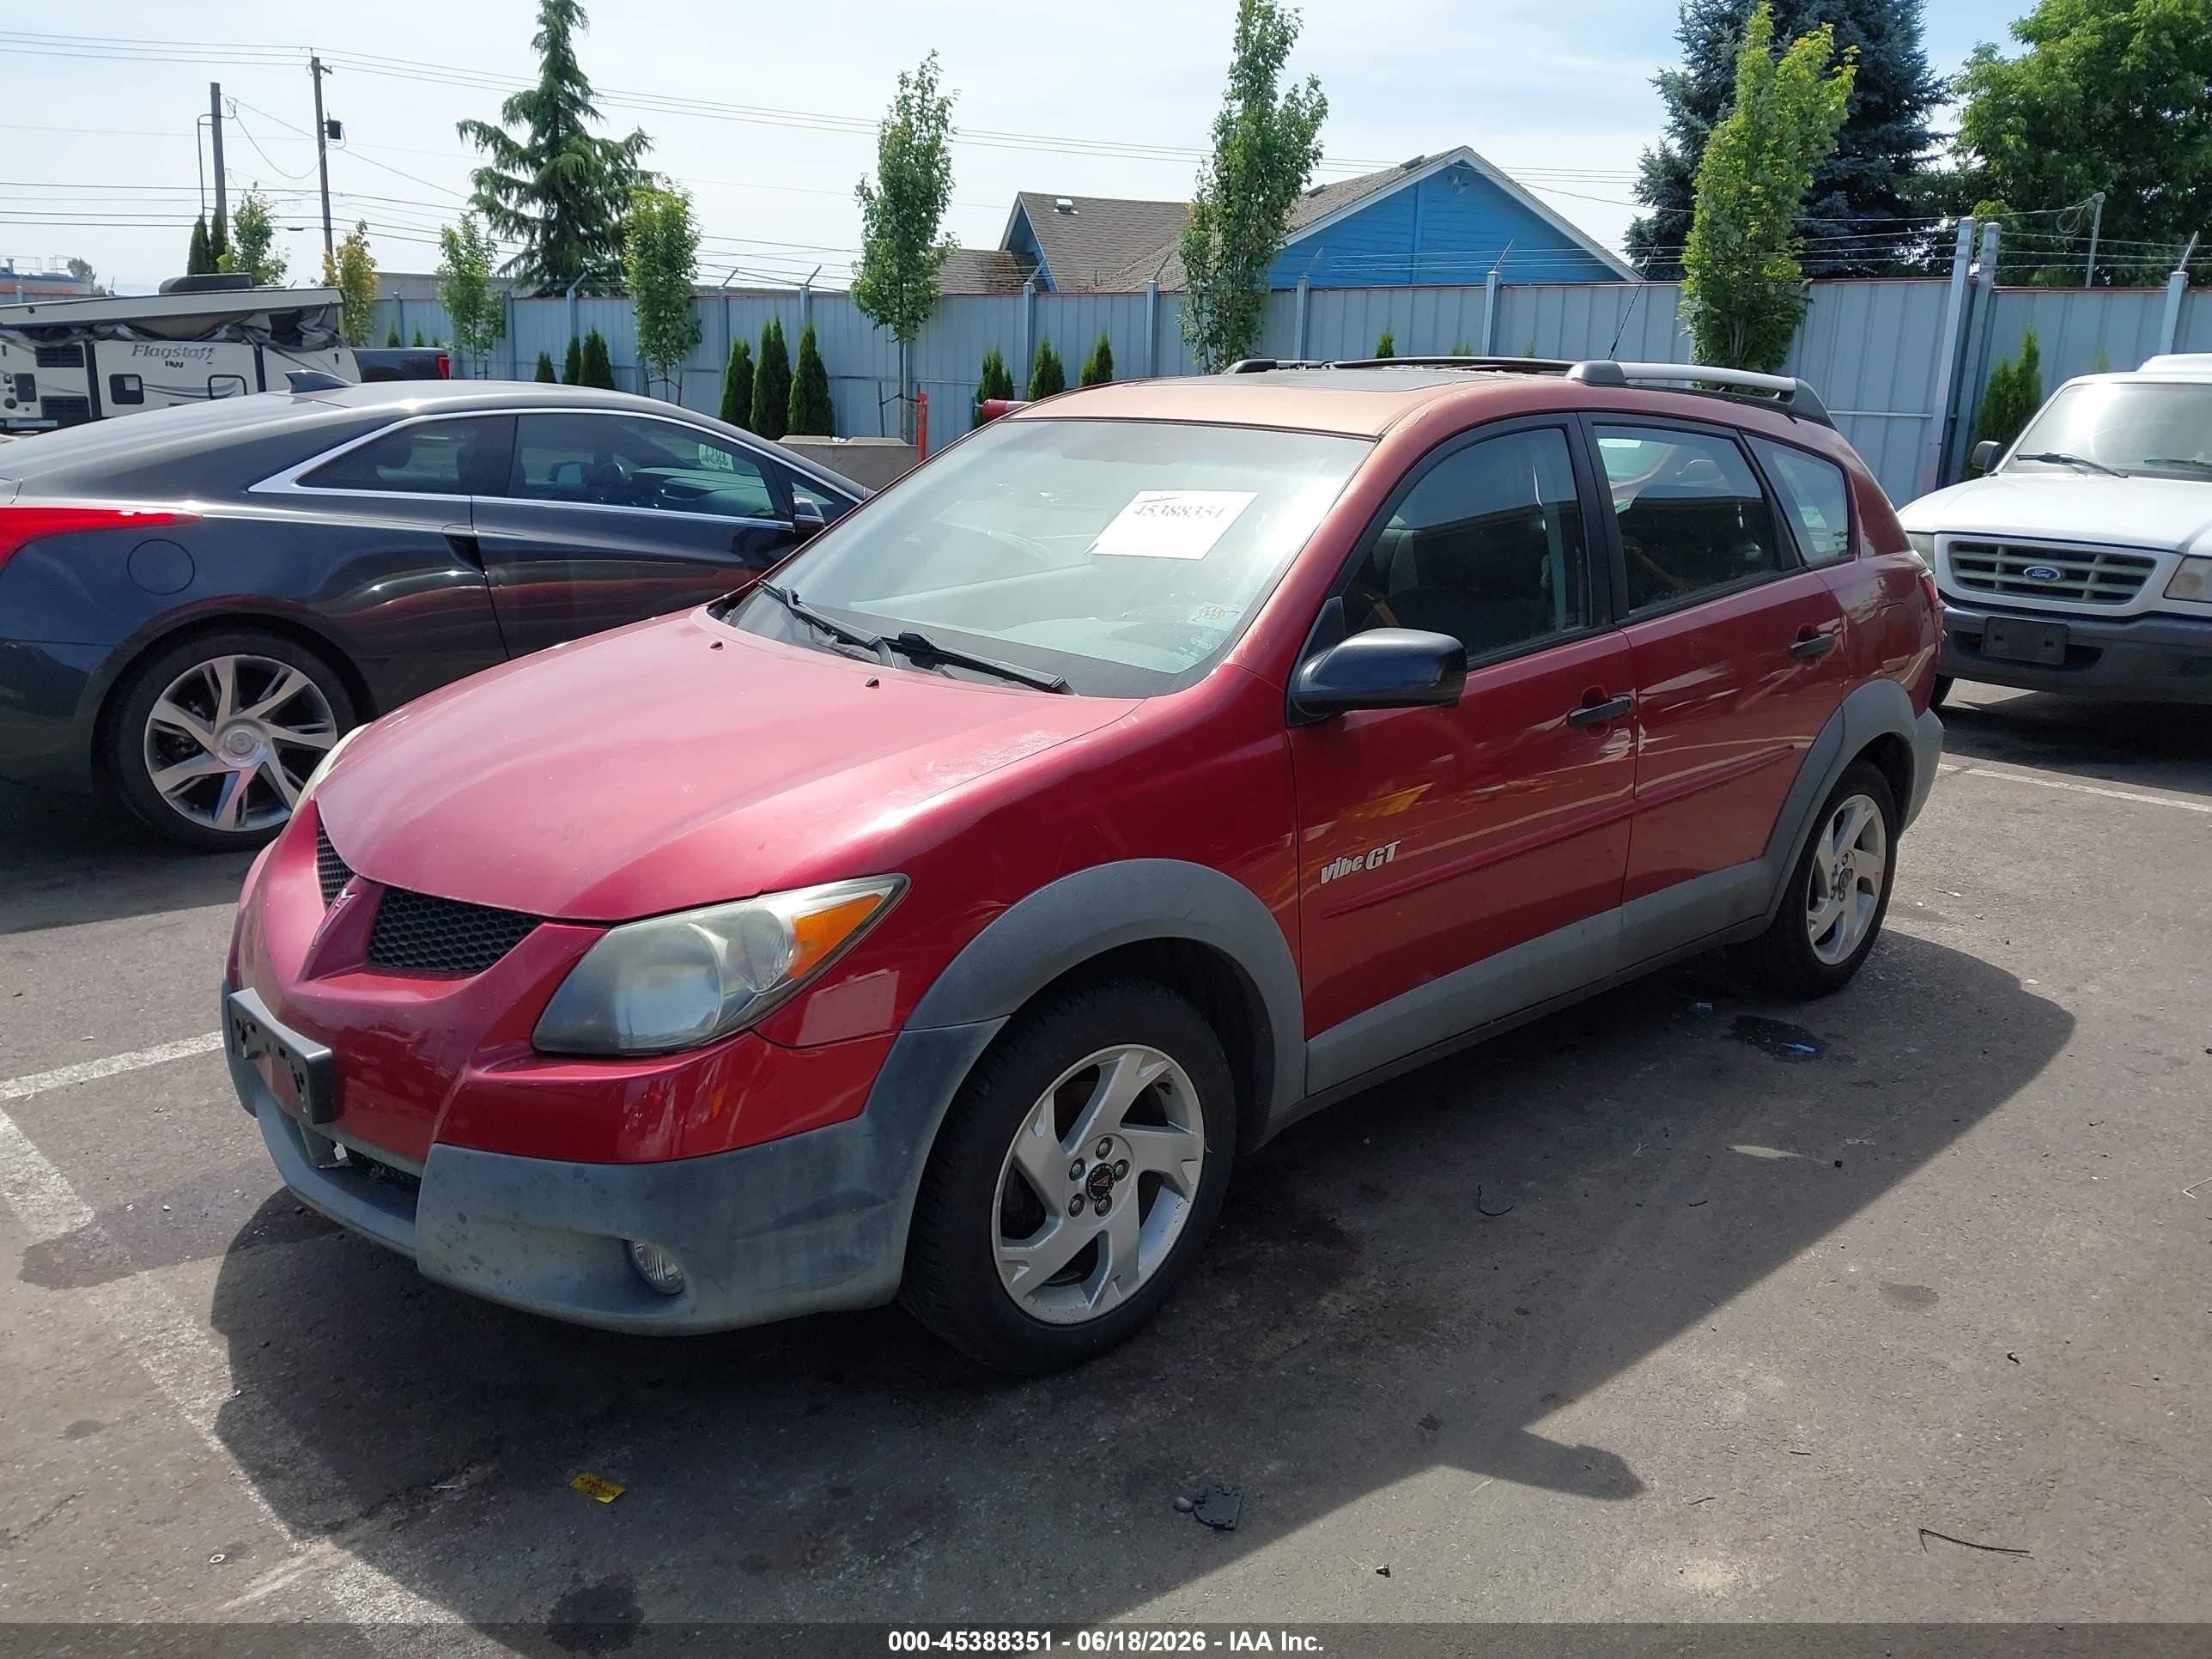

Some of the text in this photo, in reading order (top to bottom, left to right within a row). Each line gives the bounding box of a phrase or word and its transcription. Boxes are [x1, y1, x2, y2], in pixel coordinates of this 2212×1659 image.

[131, 344, 215, 360] Flagstaff
[2032, 568, 2051, 579] Ford
[1320, 840, 1401, 884] vibe GT
